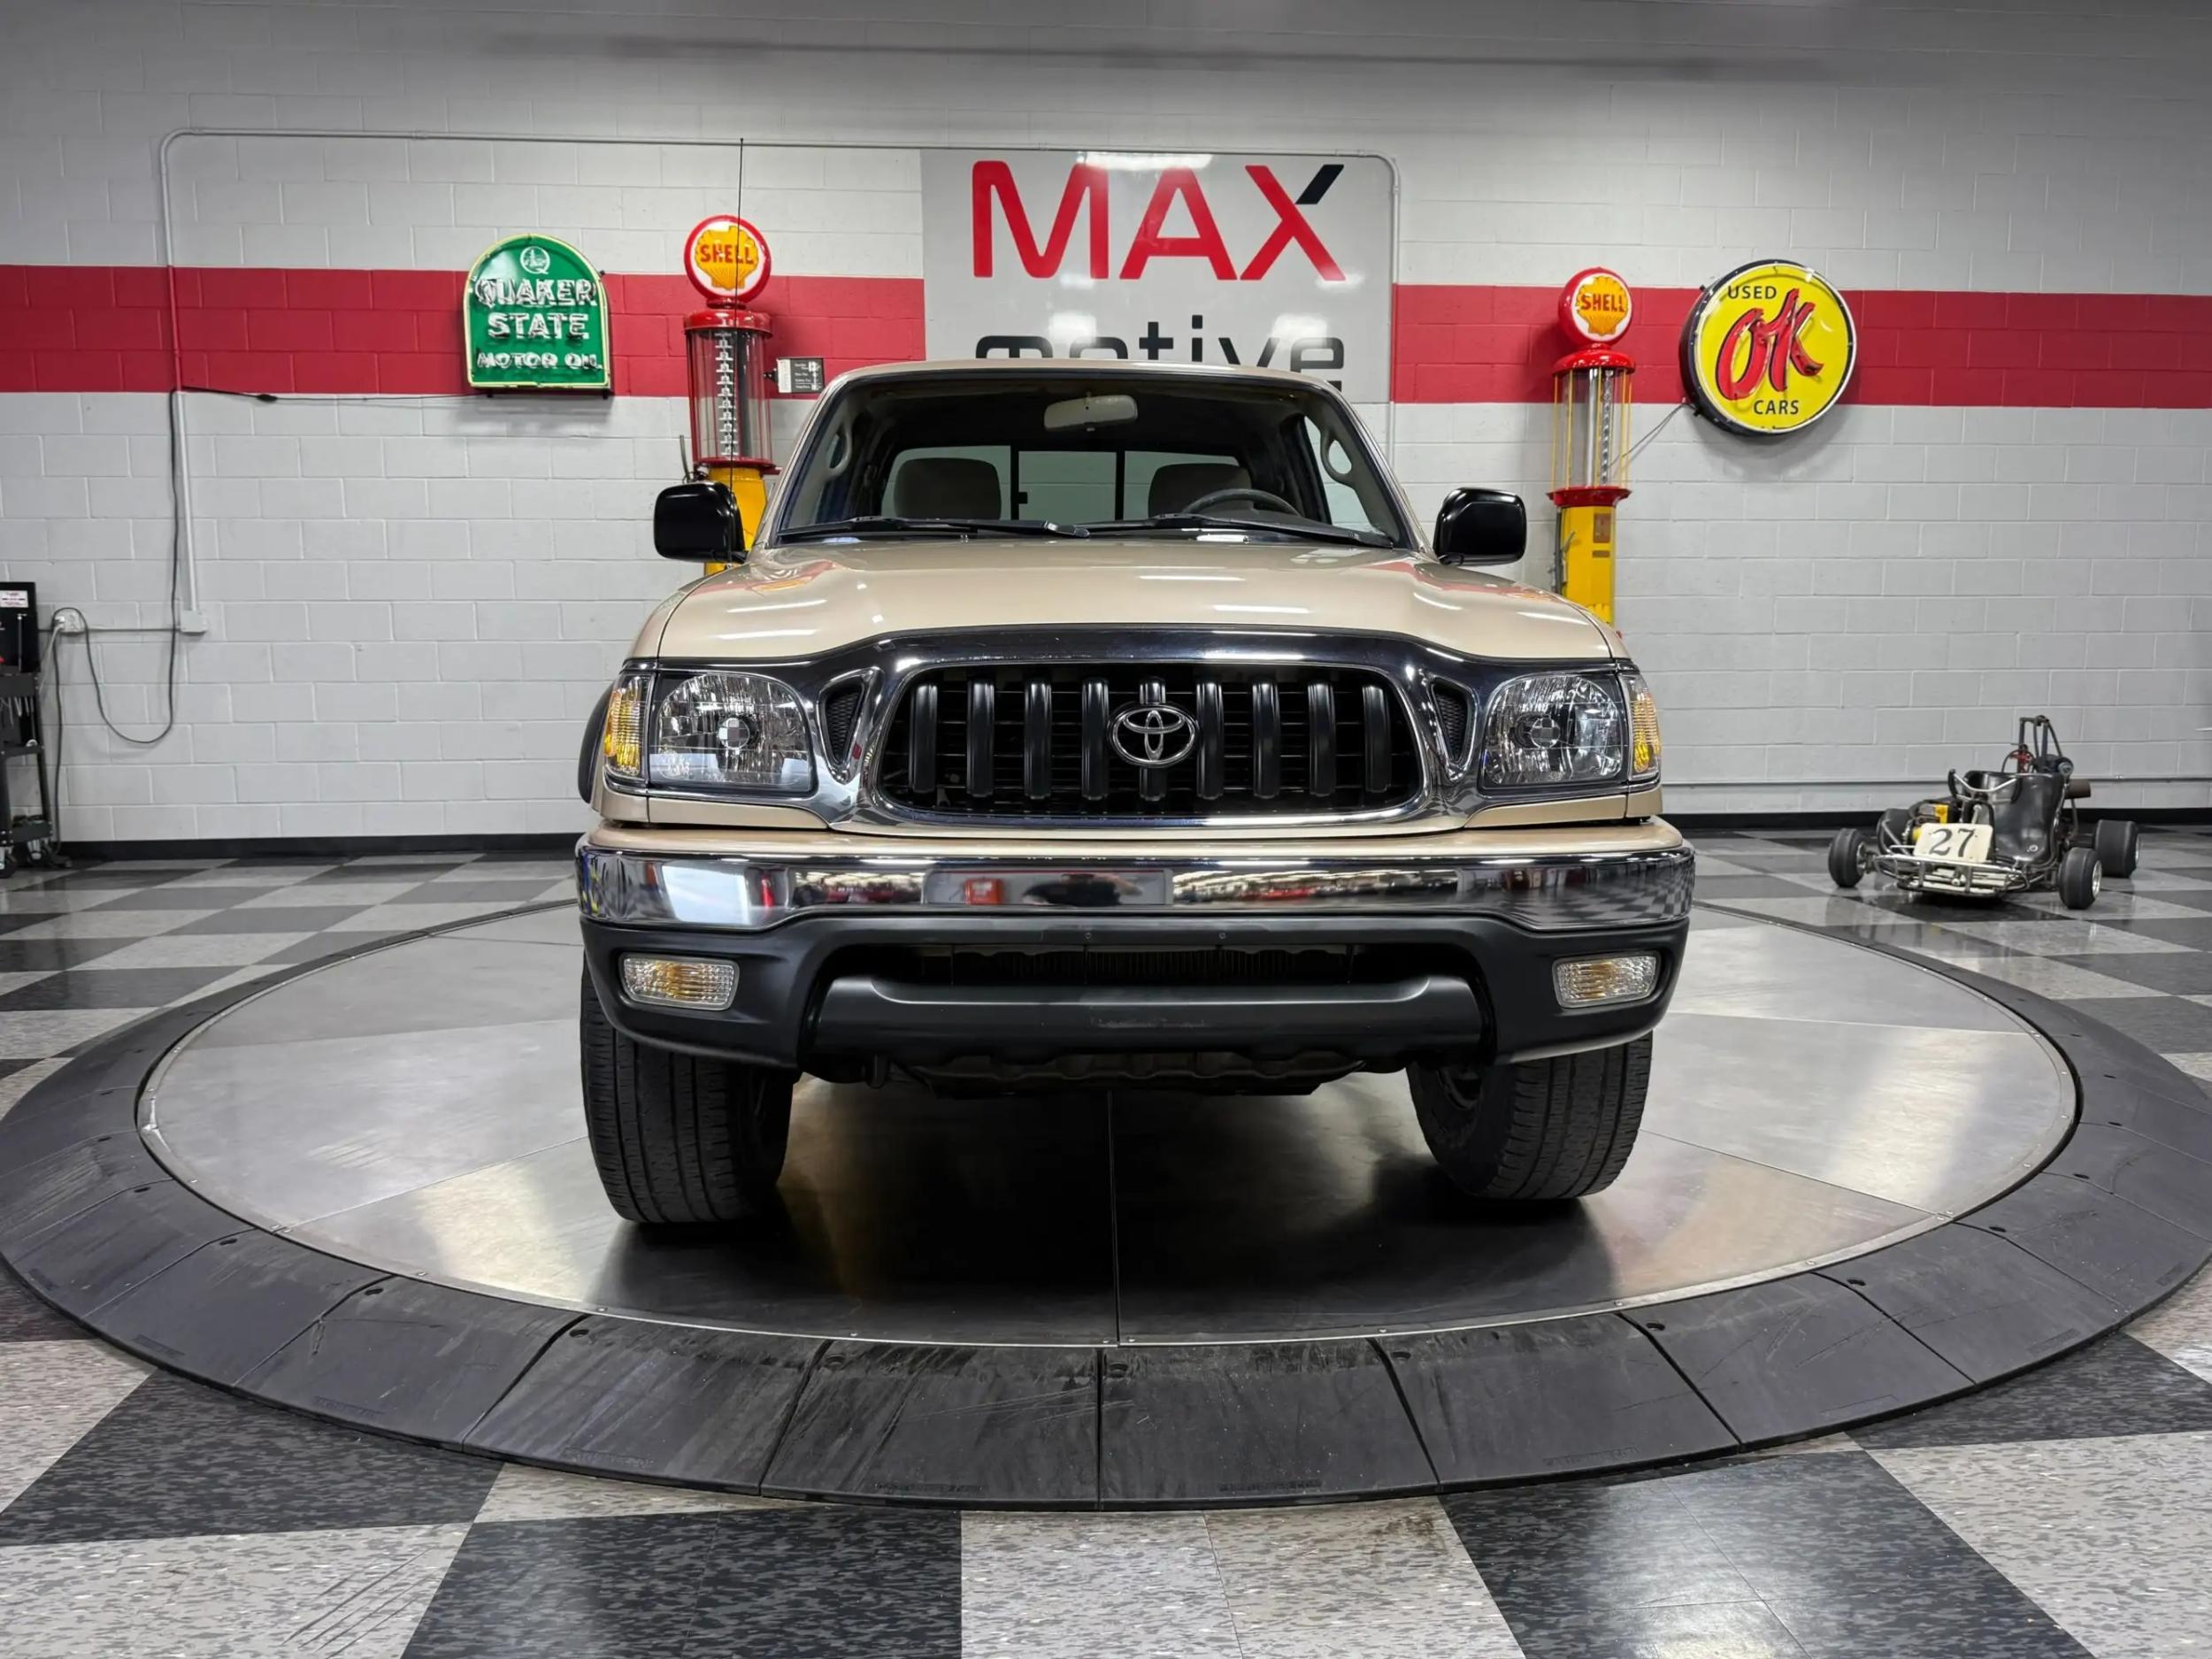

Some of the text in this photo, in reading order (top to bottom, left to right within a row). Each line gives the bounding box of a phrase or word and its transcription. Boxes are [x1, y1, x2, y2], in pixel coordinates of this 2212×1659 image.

[973, 160, 1346, 280] MAX
[699, 243, 754, 265] SHELL
[475, 278, 597, 309] QUAKER
[1580, 293, 1625, 312] SHELL
[1727, 285, 1777, 300] USED
[488, 312, 589, 340] STATE
[1716, 288, 1824, 401] OK
[477, 351, 558, 369] MOTOR
[1754, 399, 1800, 415] CARS
[1929, 828, 1976, 858] 27
